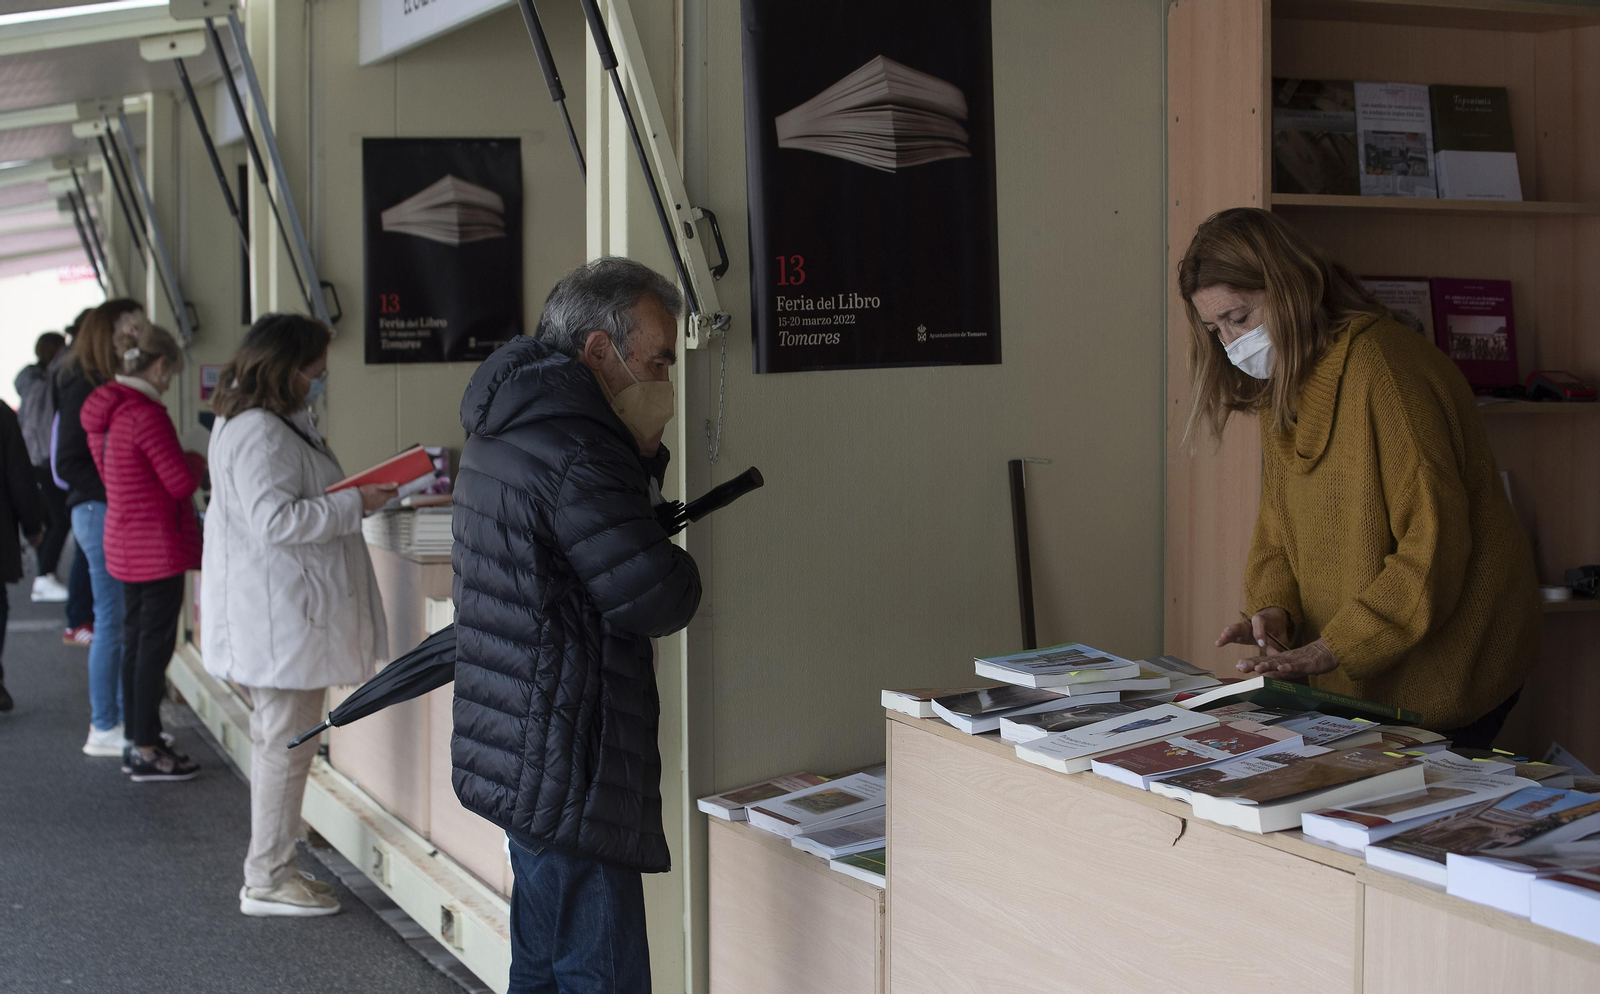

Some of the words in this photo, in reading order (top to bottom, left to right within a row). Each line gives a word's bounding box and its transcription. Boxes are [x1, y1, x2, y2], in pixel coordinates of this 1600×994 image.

[776, 254, 806, 286] 13
[380, 293, 401, 314] 13
[776, 295, 814, 312] Feria
[817, 296, 835, 310] del
[838, 292, 881, 310] Libro
[379, 317, 405, 329] Feria
[419, 316, 448, 328] Libro
[778, 316, 801, 327] 15-20
[802, 317, 832, 326] marzo
[833, 314, 856, 325] 2022
[381, 338, 422, 351] Tomares
[778, 331, 841, 347] Tomares
